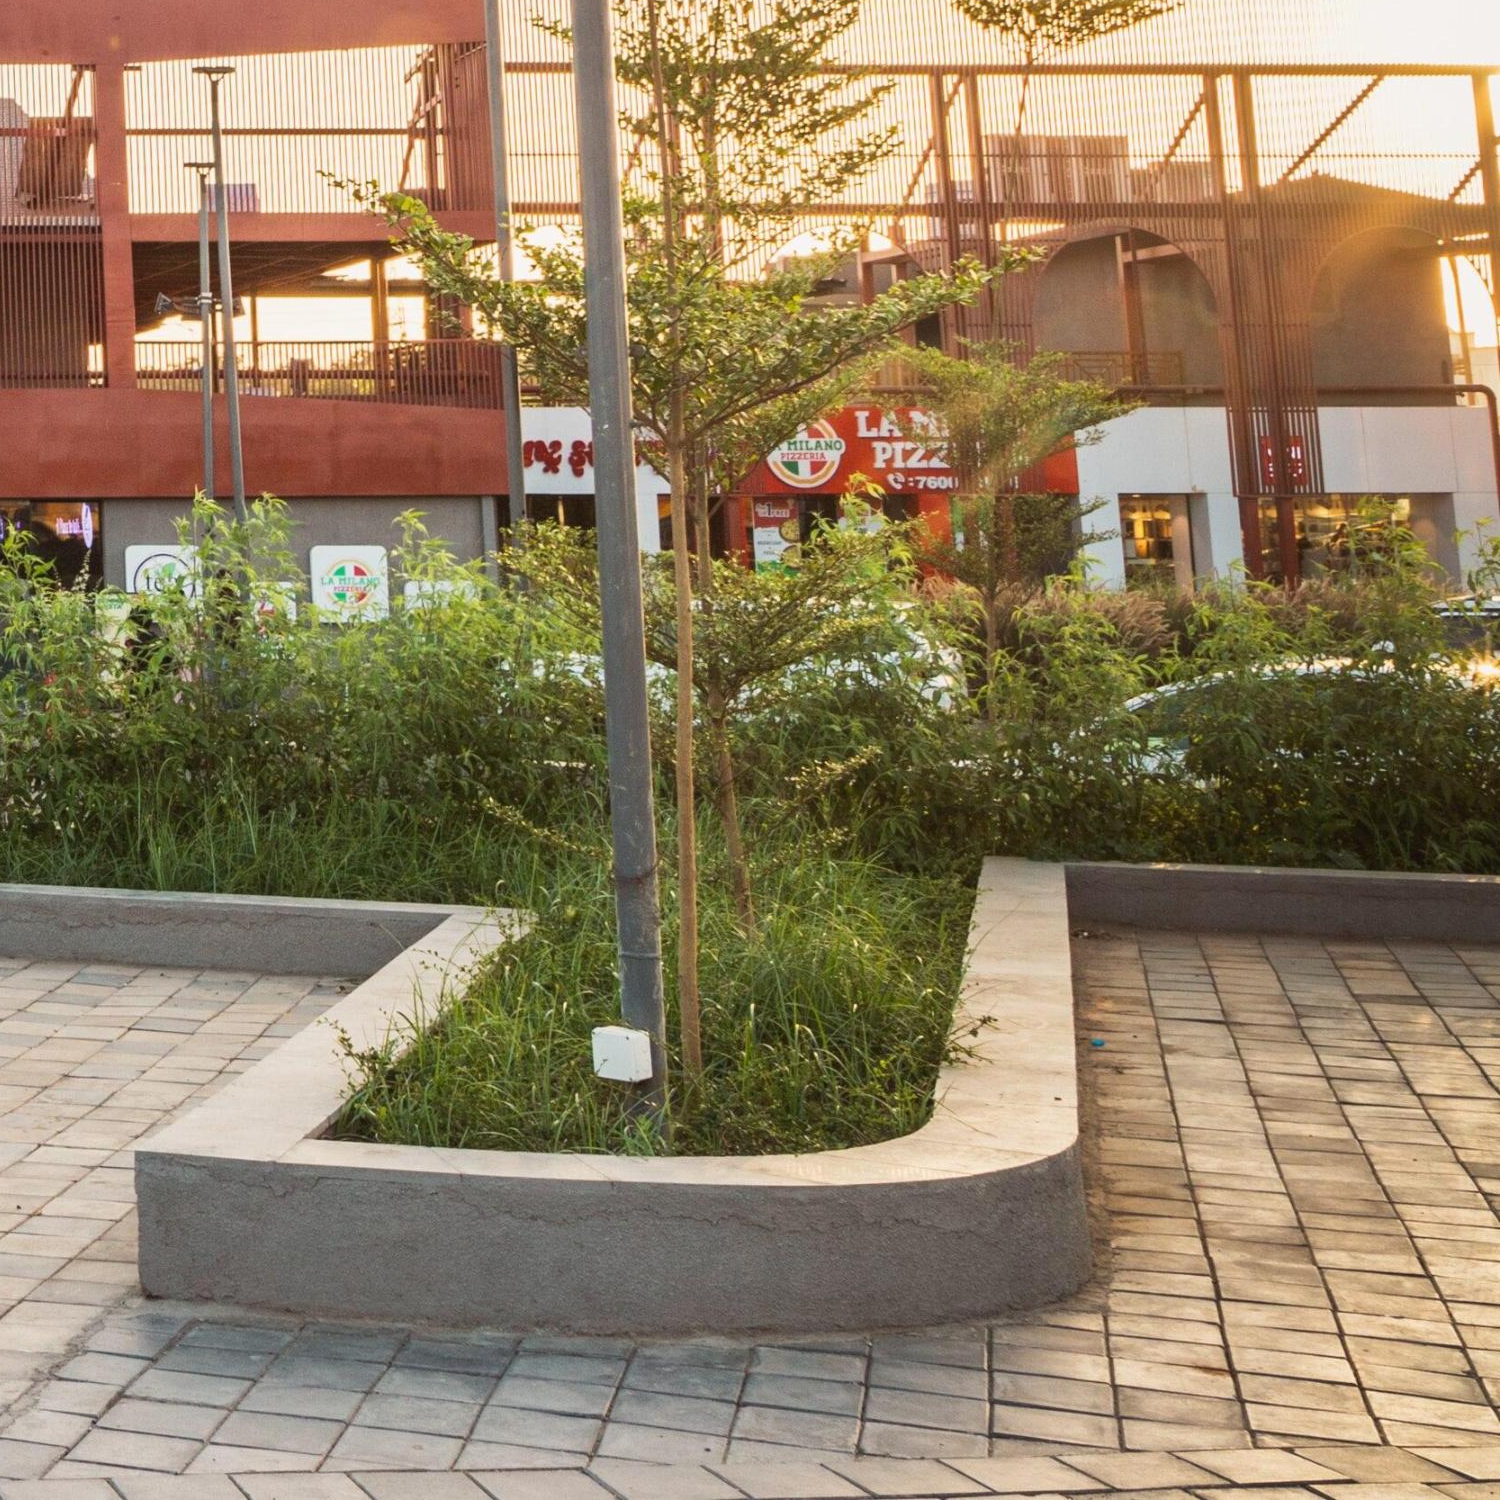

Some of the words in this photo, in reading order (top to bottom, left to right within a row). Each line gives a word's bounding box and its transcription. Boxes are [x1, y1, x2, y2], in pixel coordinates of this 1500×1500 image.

[855, 411, 902, 437] LA
[787, 440, 843, 451] MILANO
[780, 452, 826, 461] PIZZERIA
